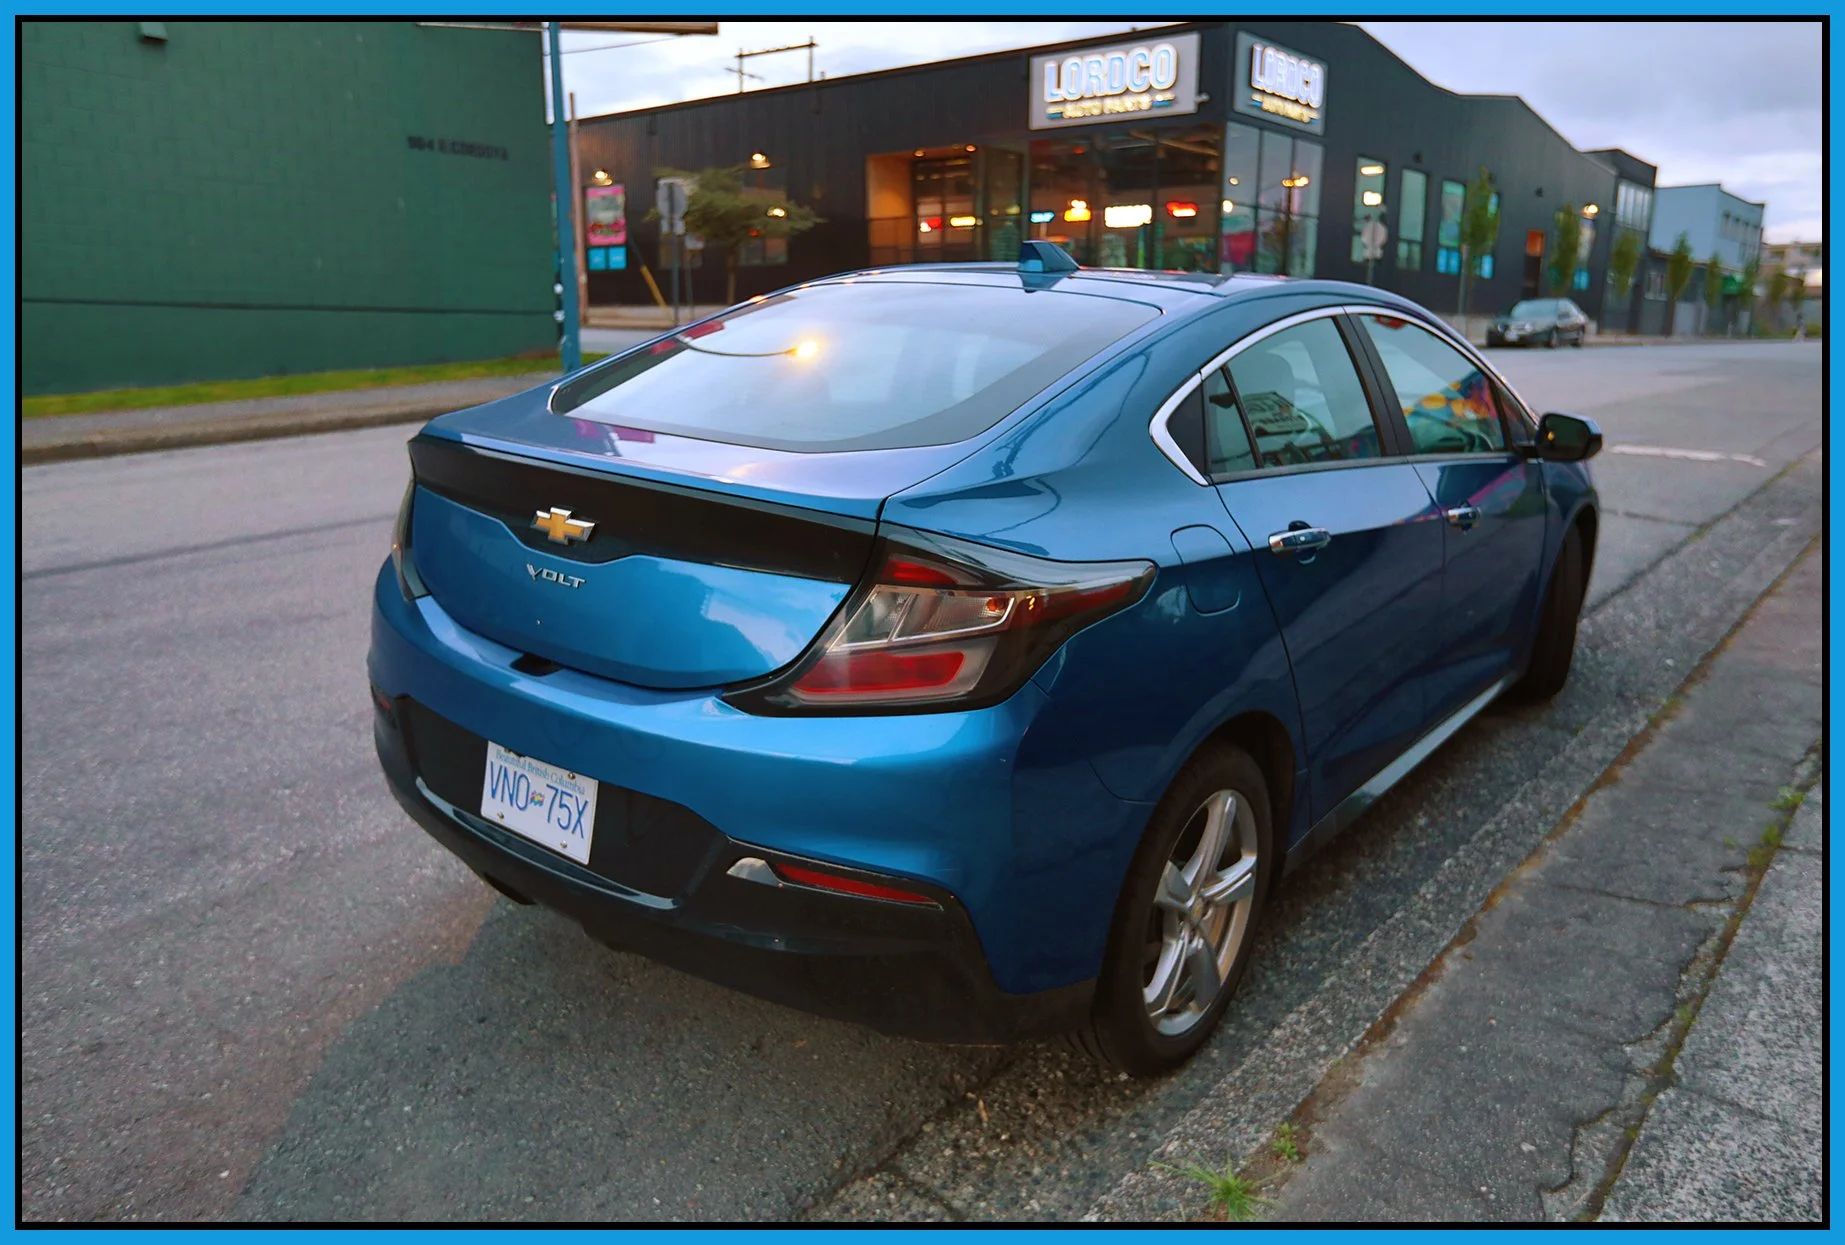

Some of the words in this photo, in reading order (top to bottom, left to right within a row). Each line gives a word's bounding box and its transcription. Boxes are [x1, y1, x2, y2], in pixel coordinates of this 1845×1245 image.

[1044, 43, 1178, 103] LORDCO
[1251, 43, 1324, 109] LORDCO
[526, 563, 586, 588] VOLT
[527, 761, 550, 779] British
[550, 771, 586, 796] Columbia
[545, 783, 589, 839] 75X
